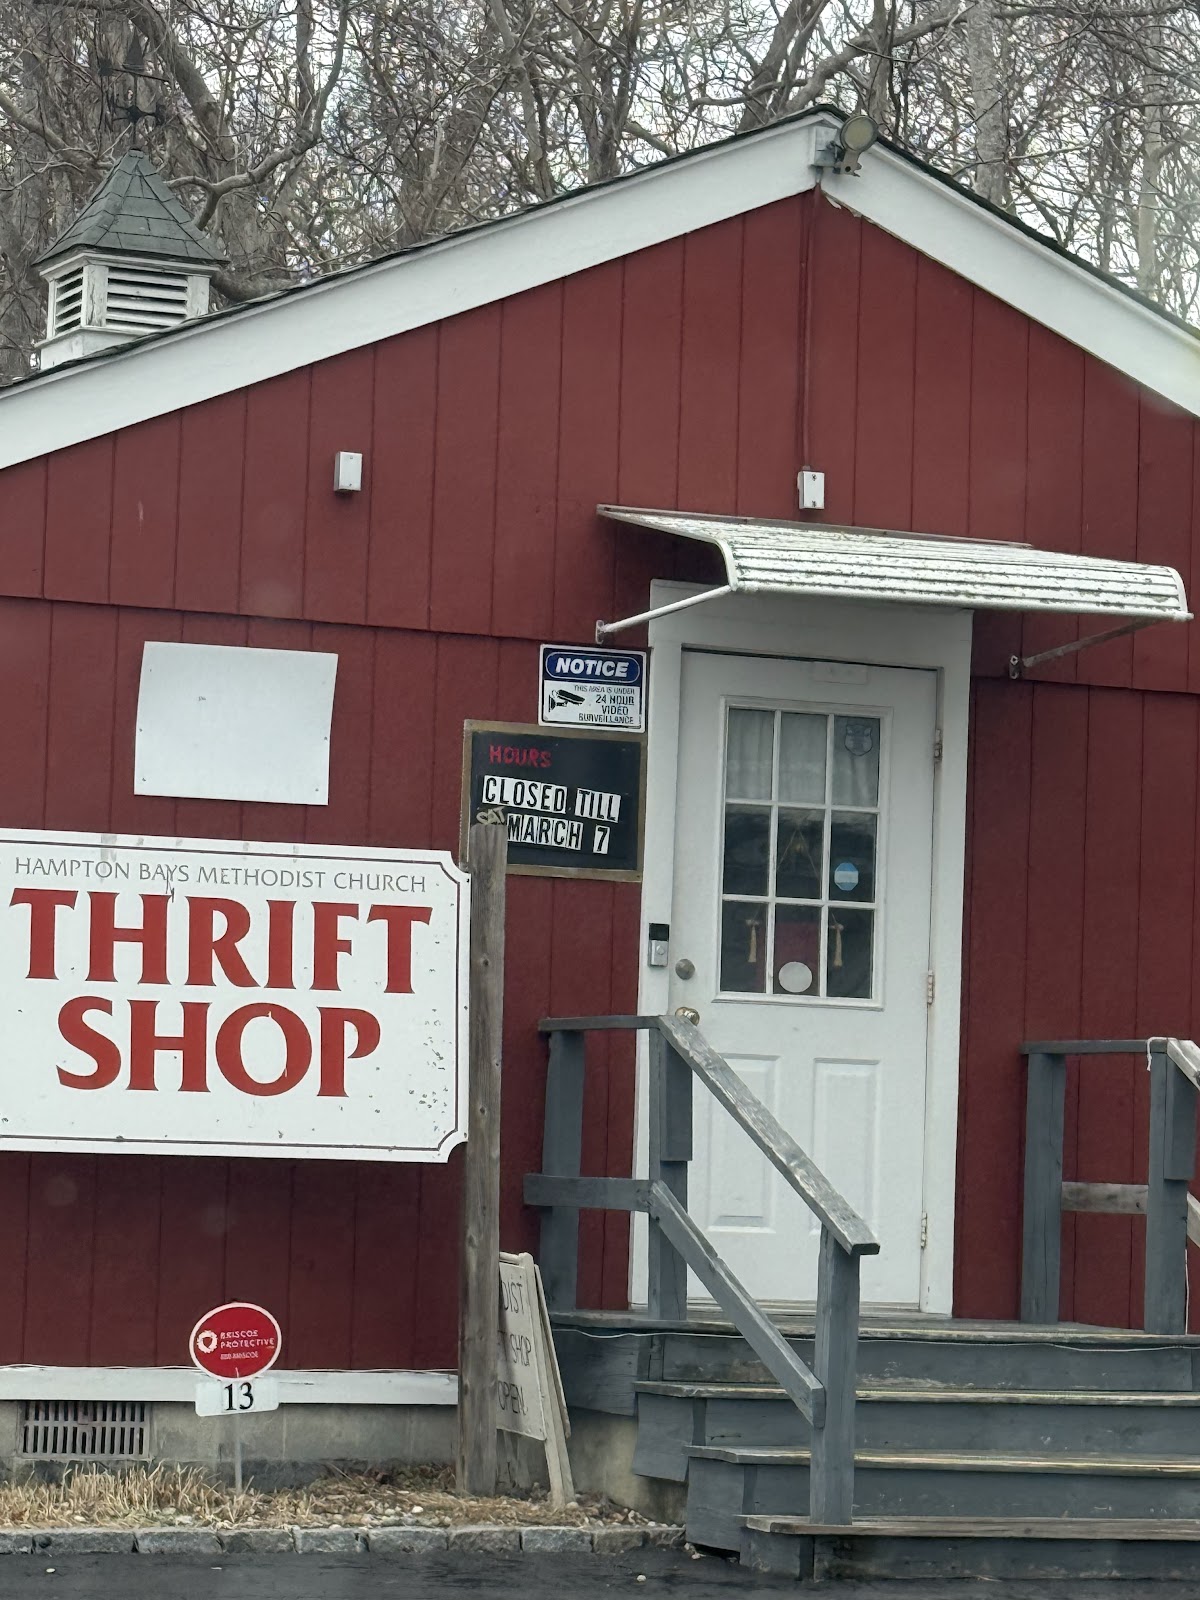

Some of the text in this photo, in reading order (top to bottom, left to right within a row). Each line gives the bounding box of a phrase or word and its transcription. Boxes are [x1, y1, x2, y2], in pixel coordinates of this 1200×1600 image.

[555, 657, 630, 677] NOTICE
[574, 684, 588, 692] THIS
[613, 687, 635, 695] UNDER
[595, 694, 635, 706] 24 HOUR
[578, 713, 634, 725] SURVEILLANCE
[601, 705, 629, 715] VIDEO
[489, 744, 552, 768] HOURS
[485, 777, 620, 821] CLOSED TILL
[507, 814, 609, 852] MARCH 7
[15, 857, 427, 893] HAMPTON BAYS METHODIST CHURCH
[9, 887, 433, 994] THRIFT
[55, 995, 382, 1098] SHOP
[220, 1329, 259, 1340] BRISCOE
[220, 1337, 275, 1349] PROTECTIVE
[224, 1382, 254, 1411] 13
[498, 1380, 527, 1415] OPEN
